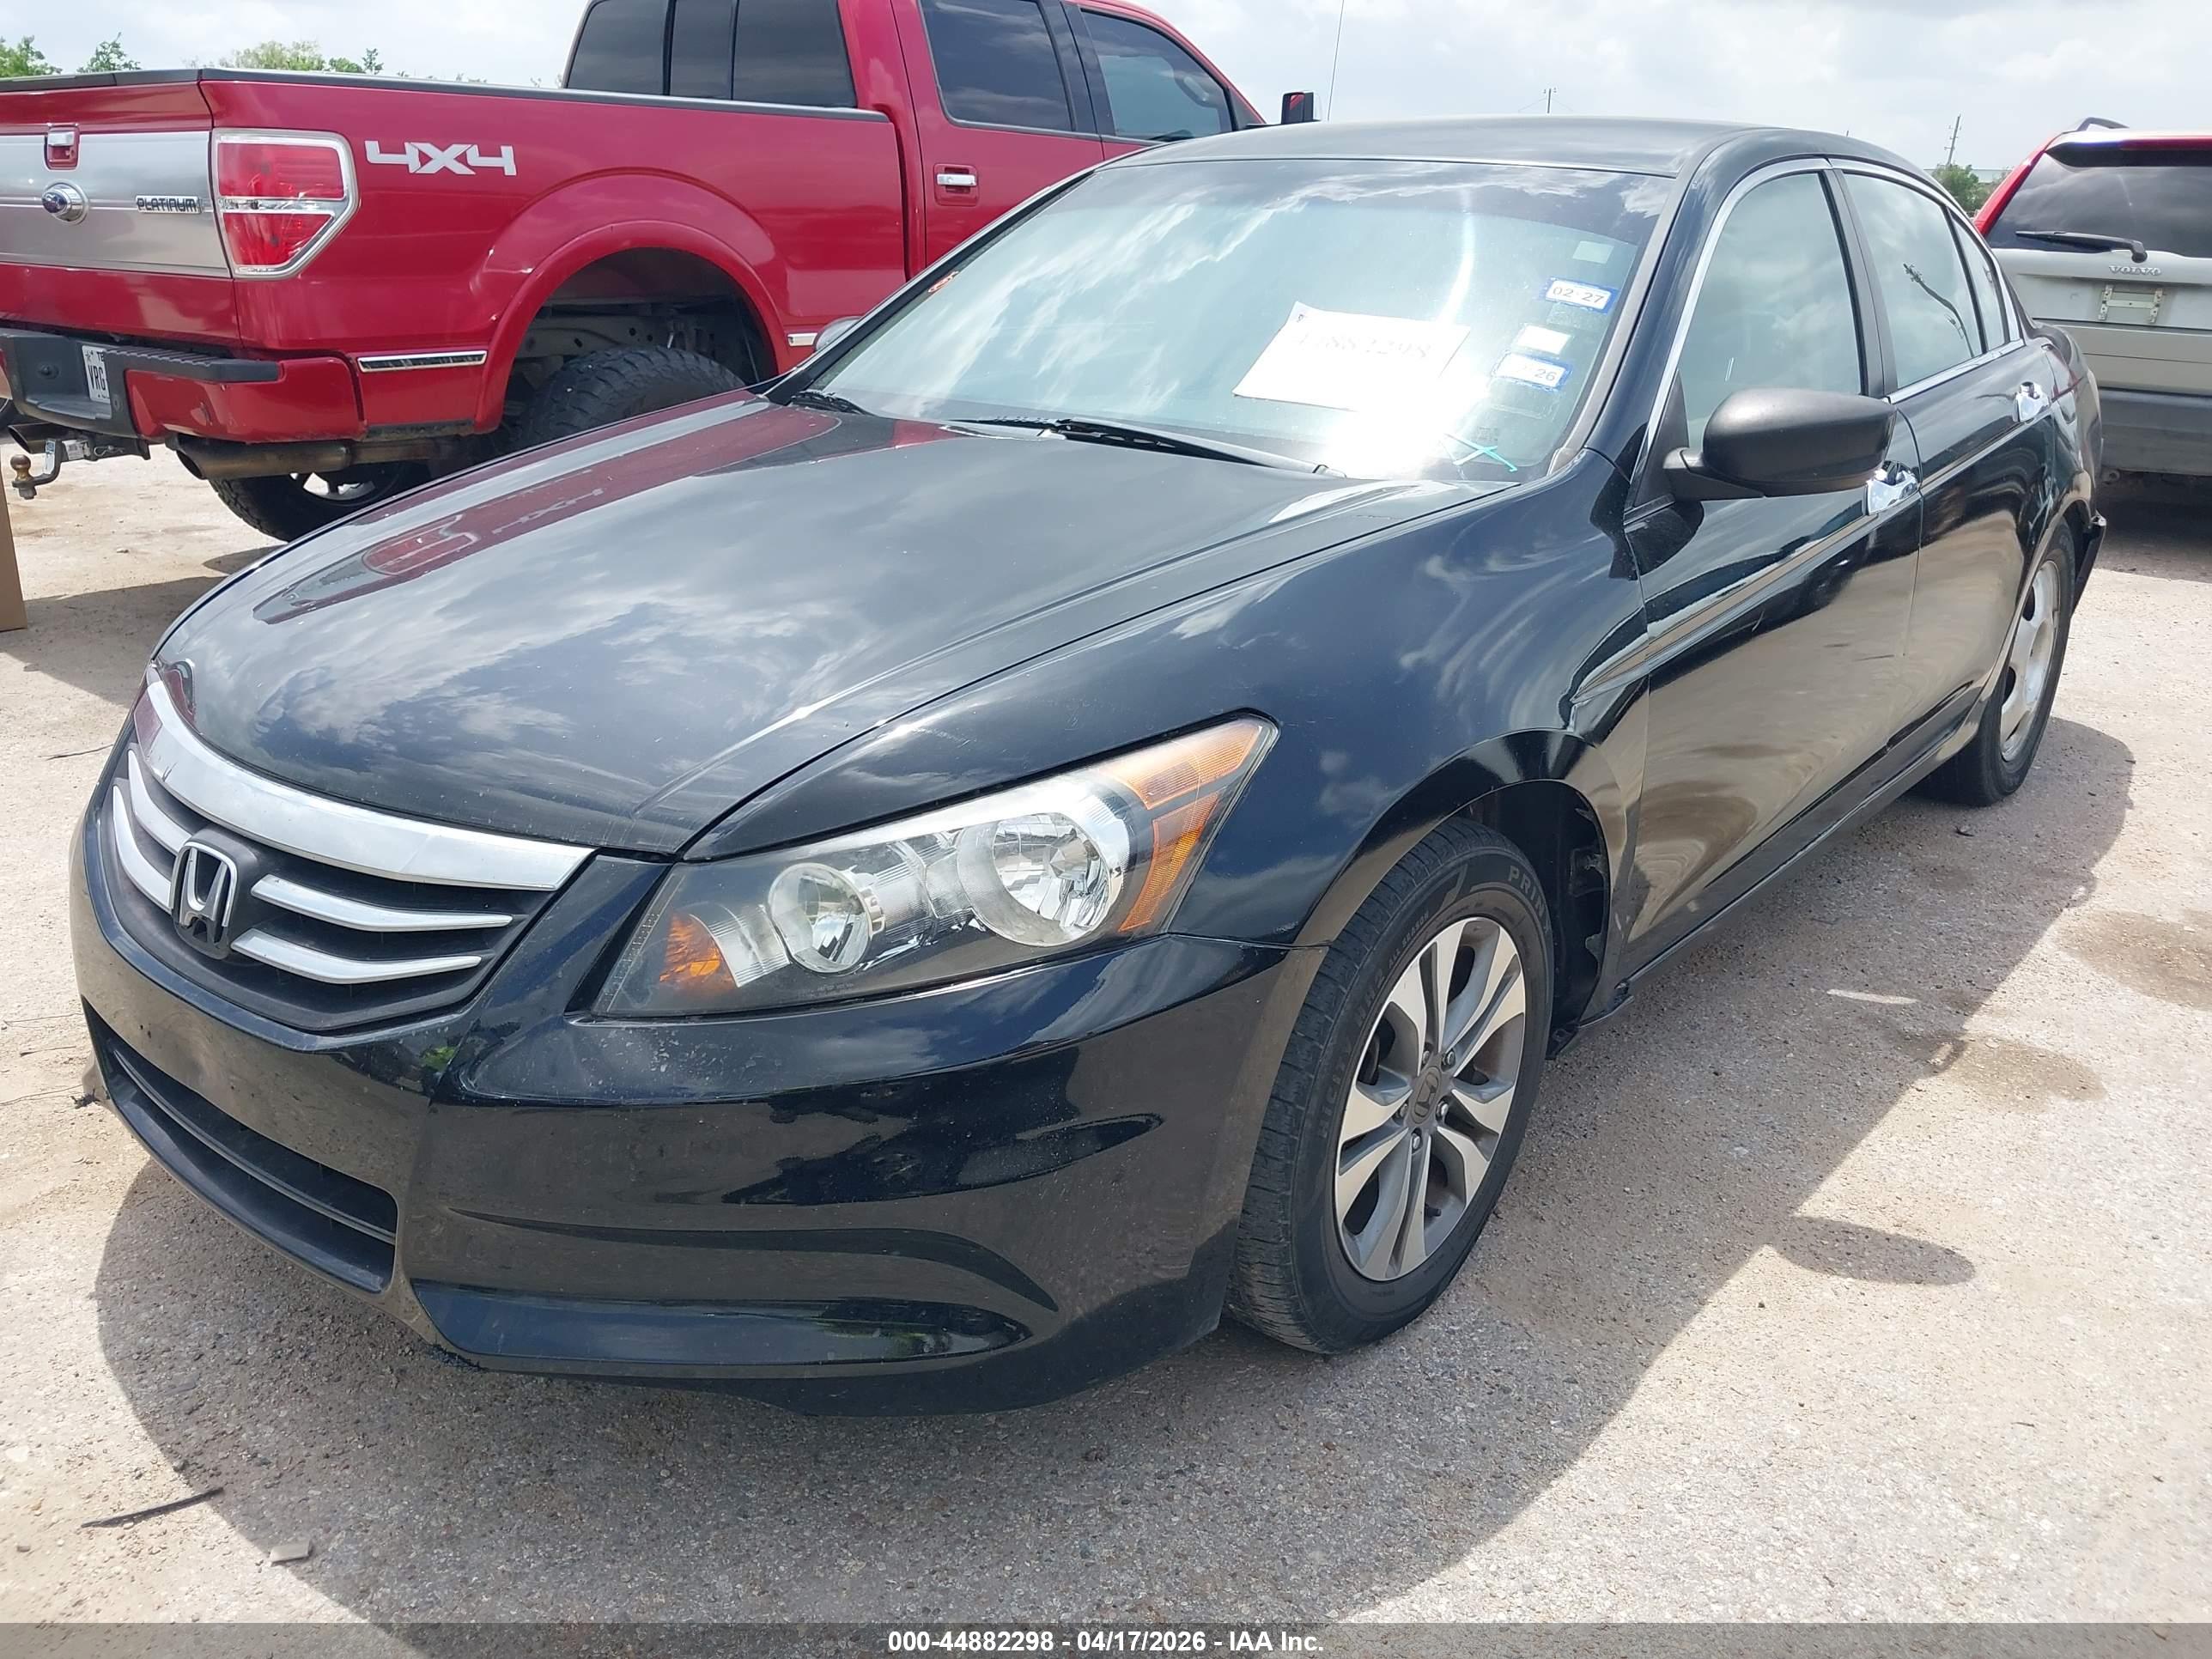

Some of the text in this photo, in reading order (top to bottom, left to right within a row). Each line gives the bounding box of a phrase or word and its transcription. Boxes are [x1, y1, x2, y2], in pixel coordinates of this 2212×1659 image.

[364, 140, 517, 176] 4X4
[137, 198, 198, 212] PLATINUM
[2109, 265, 2161, 276] VOLVO
